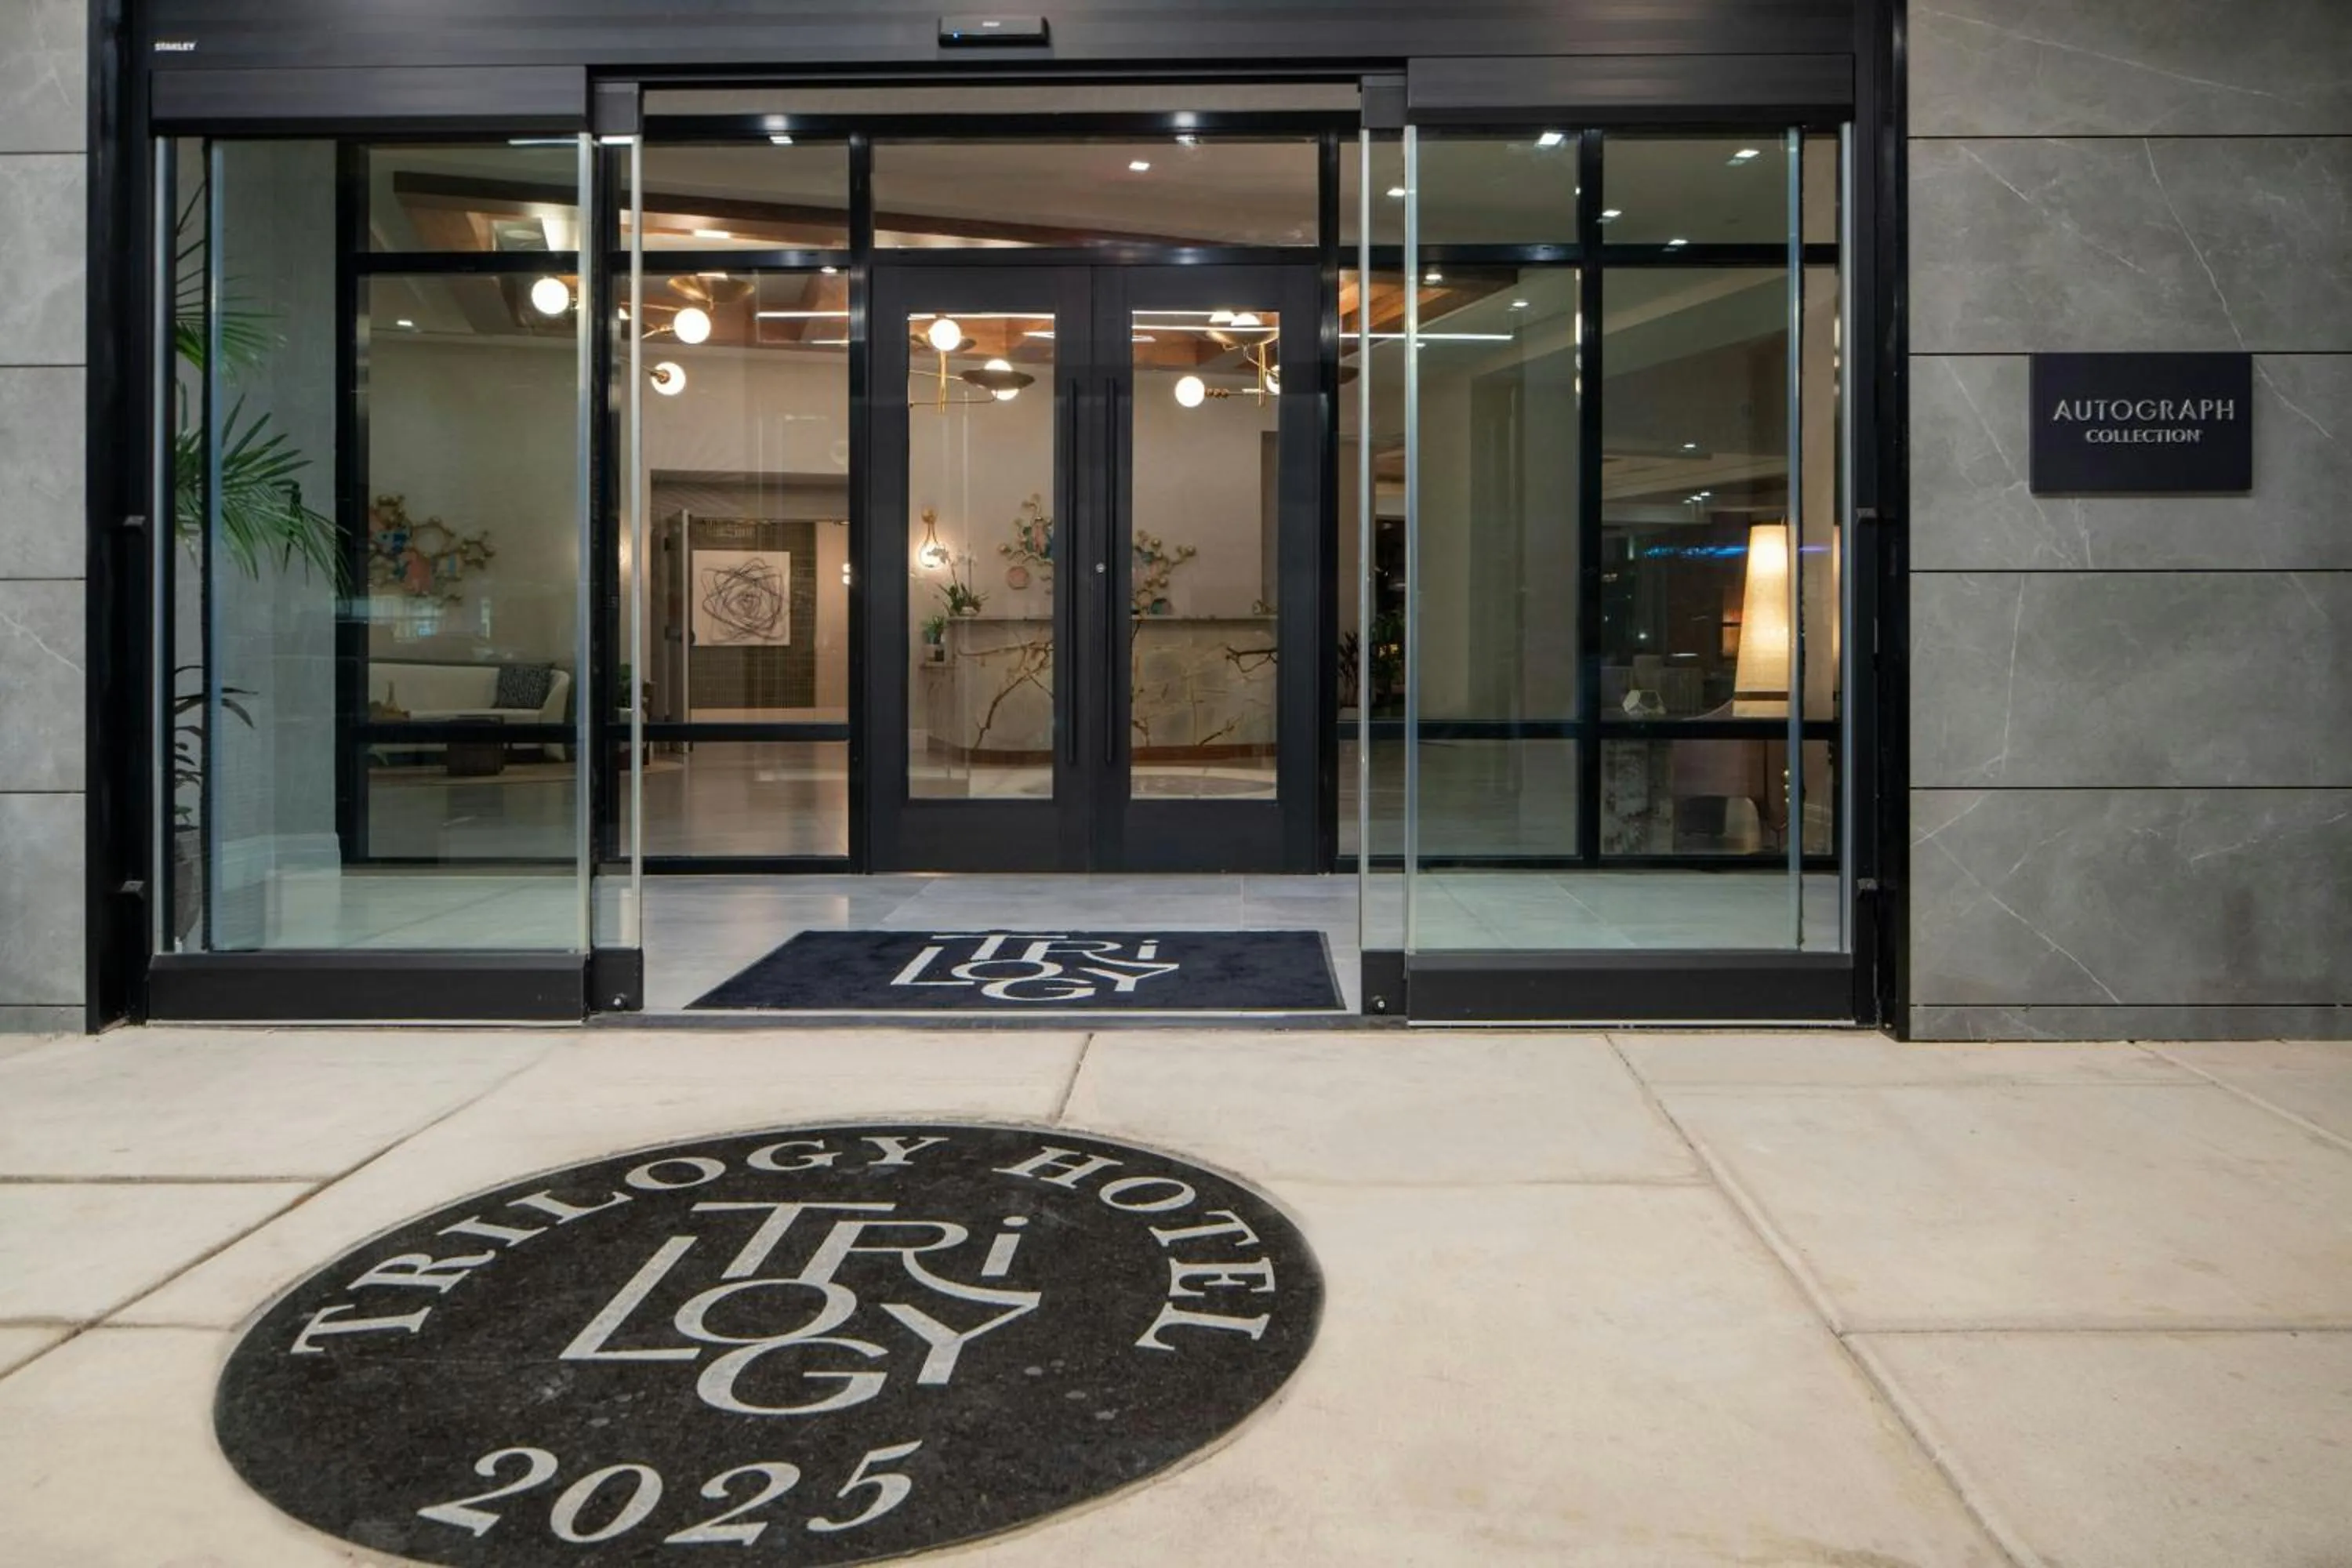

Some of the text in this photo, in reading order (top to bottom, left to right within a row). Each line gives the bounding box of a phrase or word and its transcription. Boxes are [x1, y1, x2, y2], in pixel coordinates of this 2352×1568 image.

[154, 41, 197, 51] STANLEY
[2053, 399, 2234, 421] AUTOGRAPH
[2085, 429, 2201, 443] COLLECTION
[291, 1137, 1276, 1353] TRILOGY HOTEL
[418, 1439, 923, 1544] 2025
